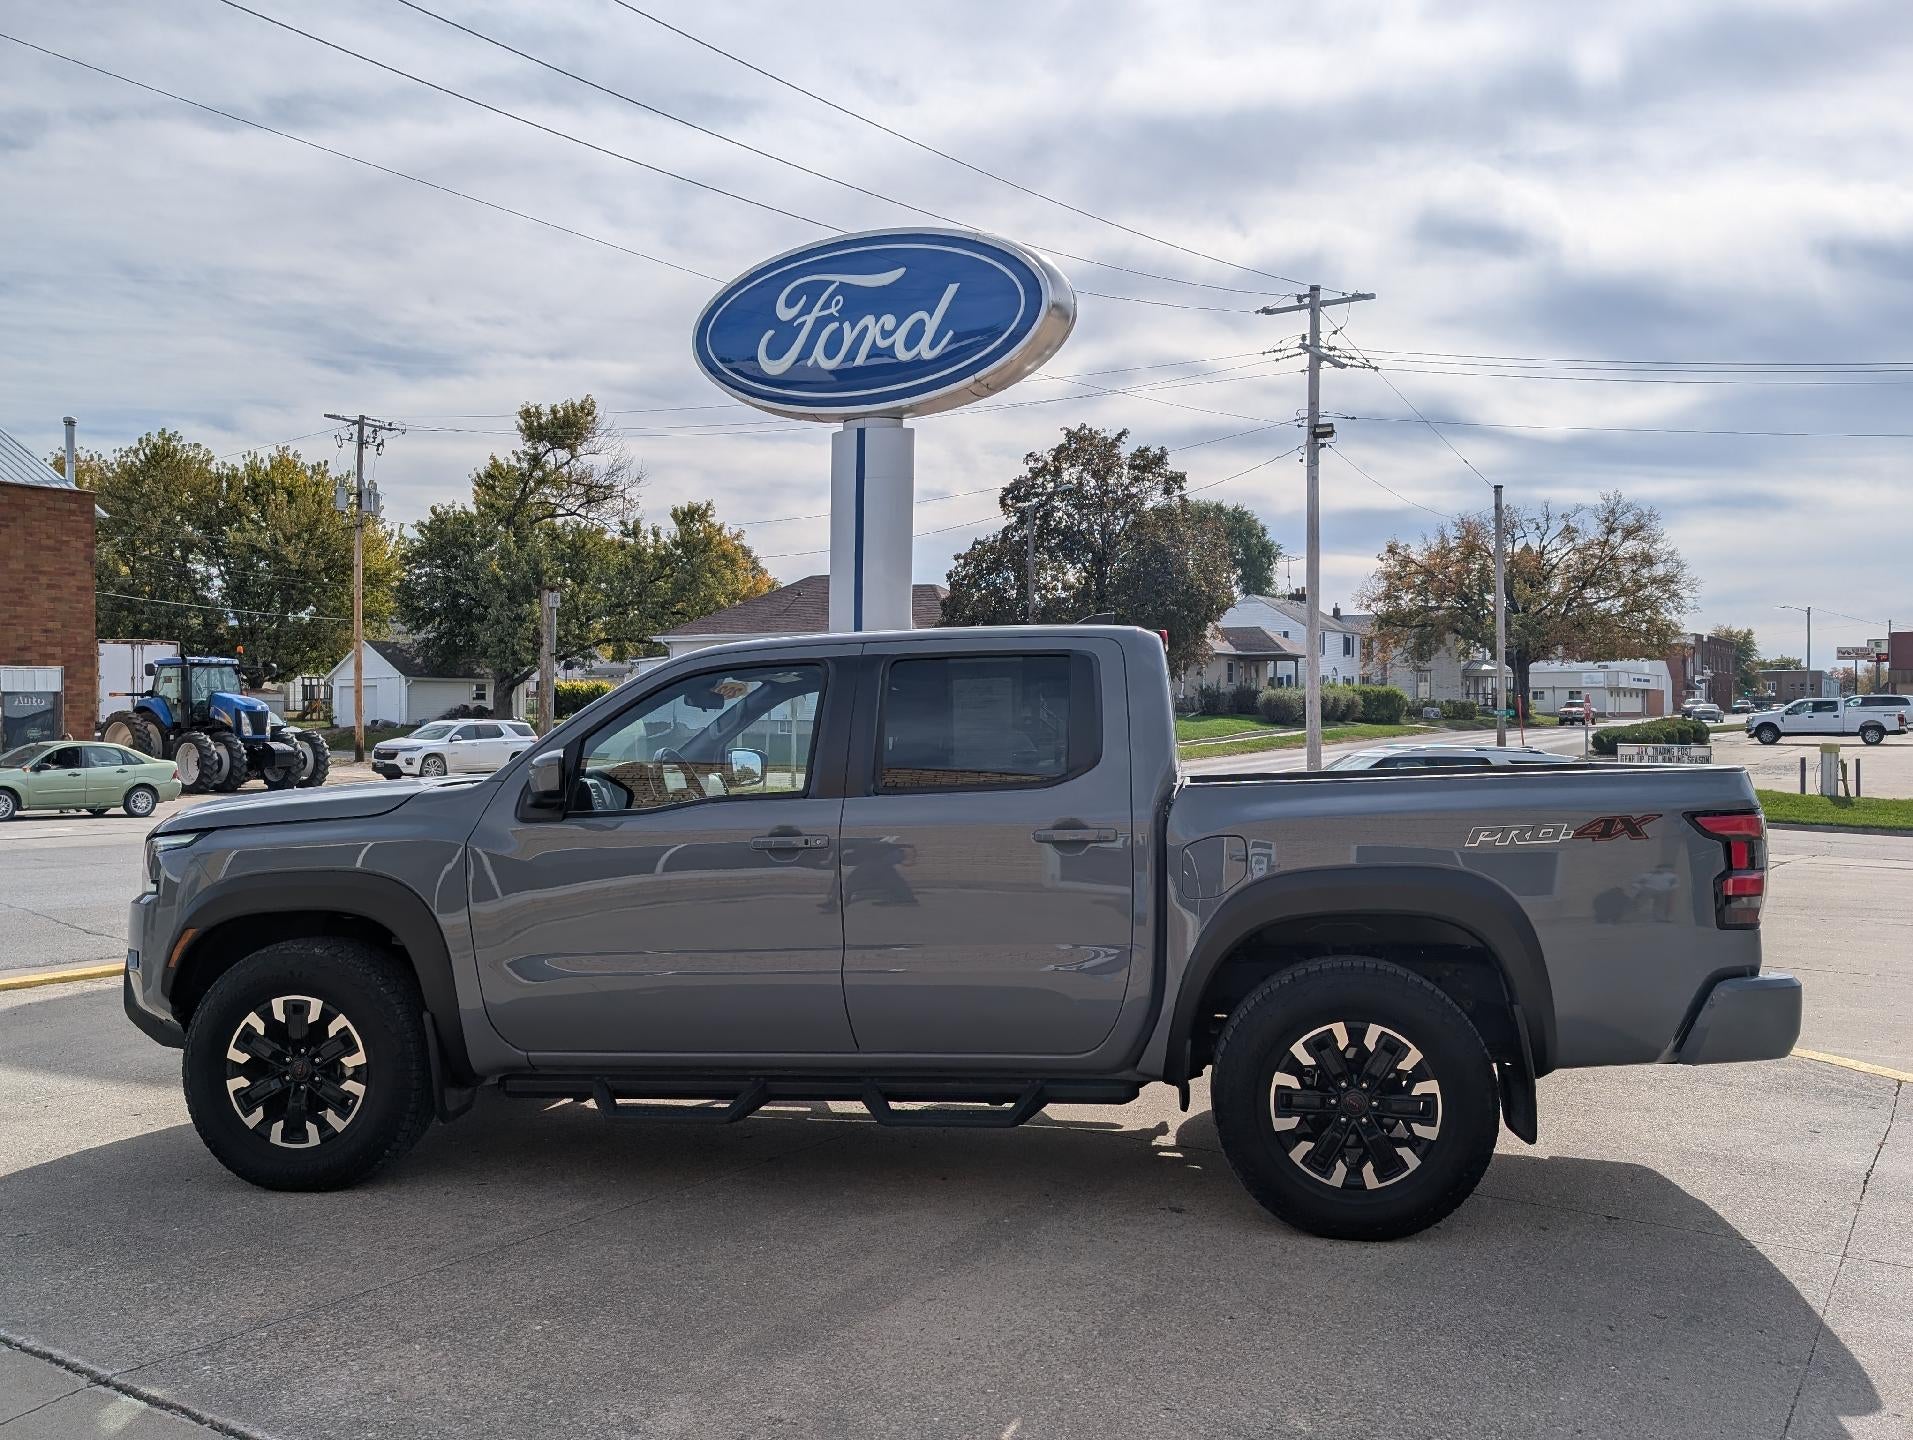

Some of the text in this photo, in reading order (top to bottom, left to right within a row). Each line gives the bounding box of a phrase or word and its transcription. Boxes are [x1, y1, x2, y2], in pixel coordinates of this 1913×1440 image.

[757, 267, 960, 376] Ford
[13, 696, 45, 706] Auto
[1652, 746, 1675, 756] TRADING
[1677, 746, 1693, 756] POST
[1648, 755, 1659, 764] FOR
[1687, 755, 1710, 764] SEASON
